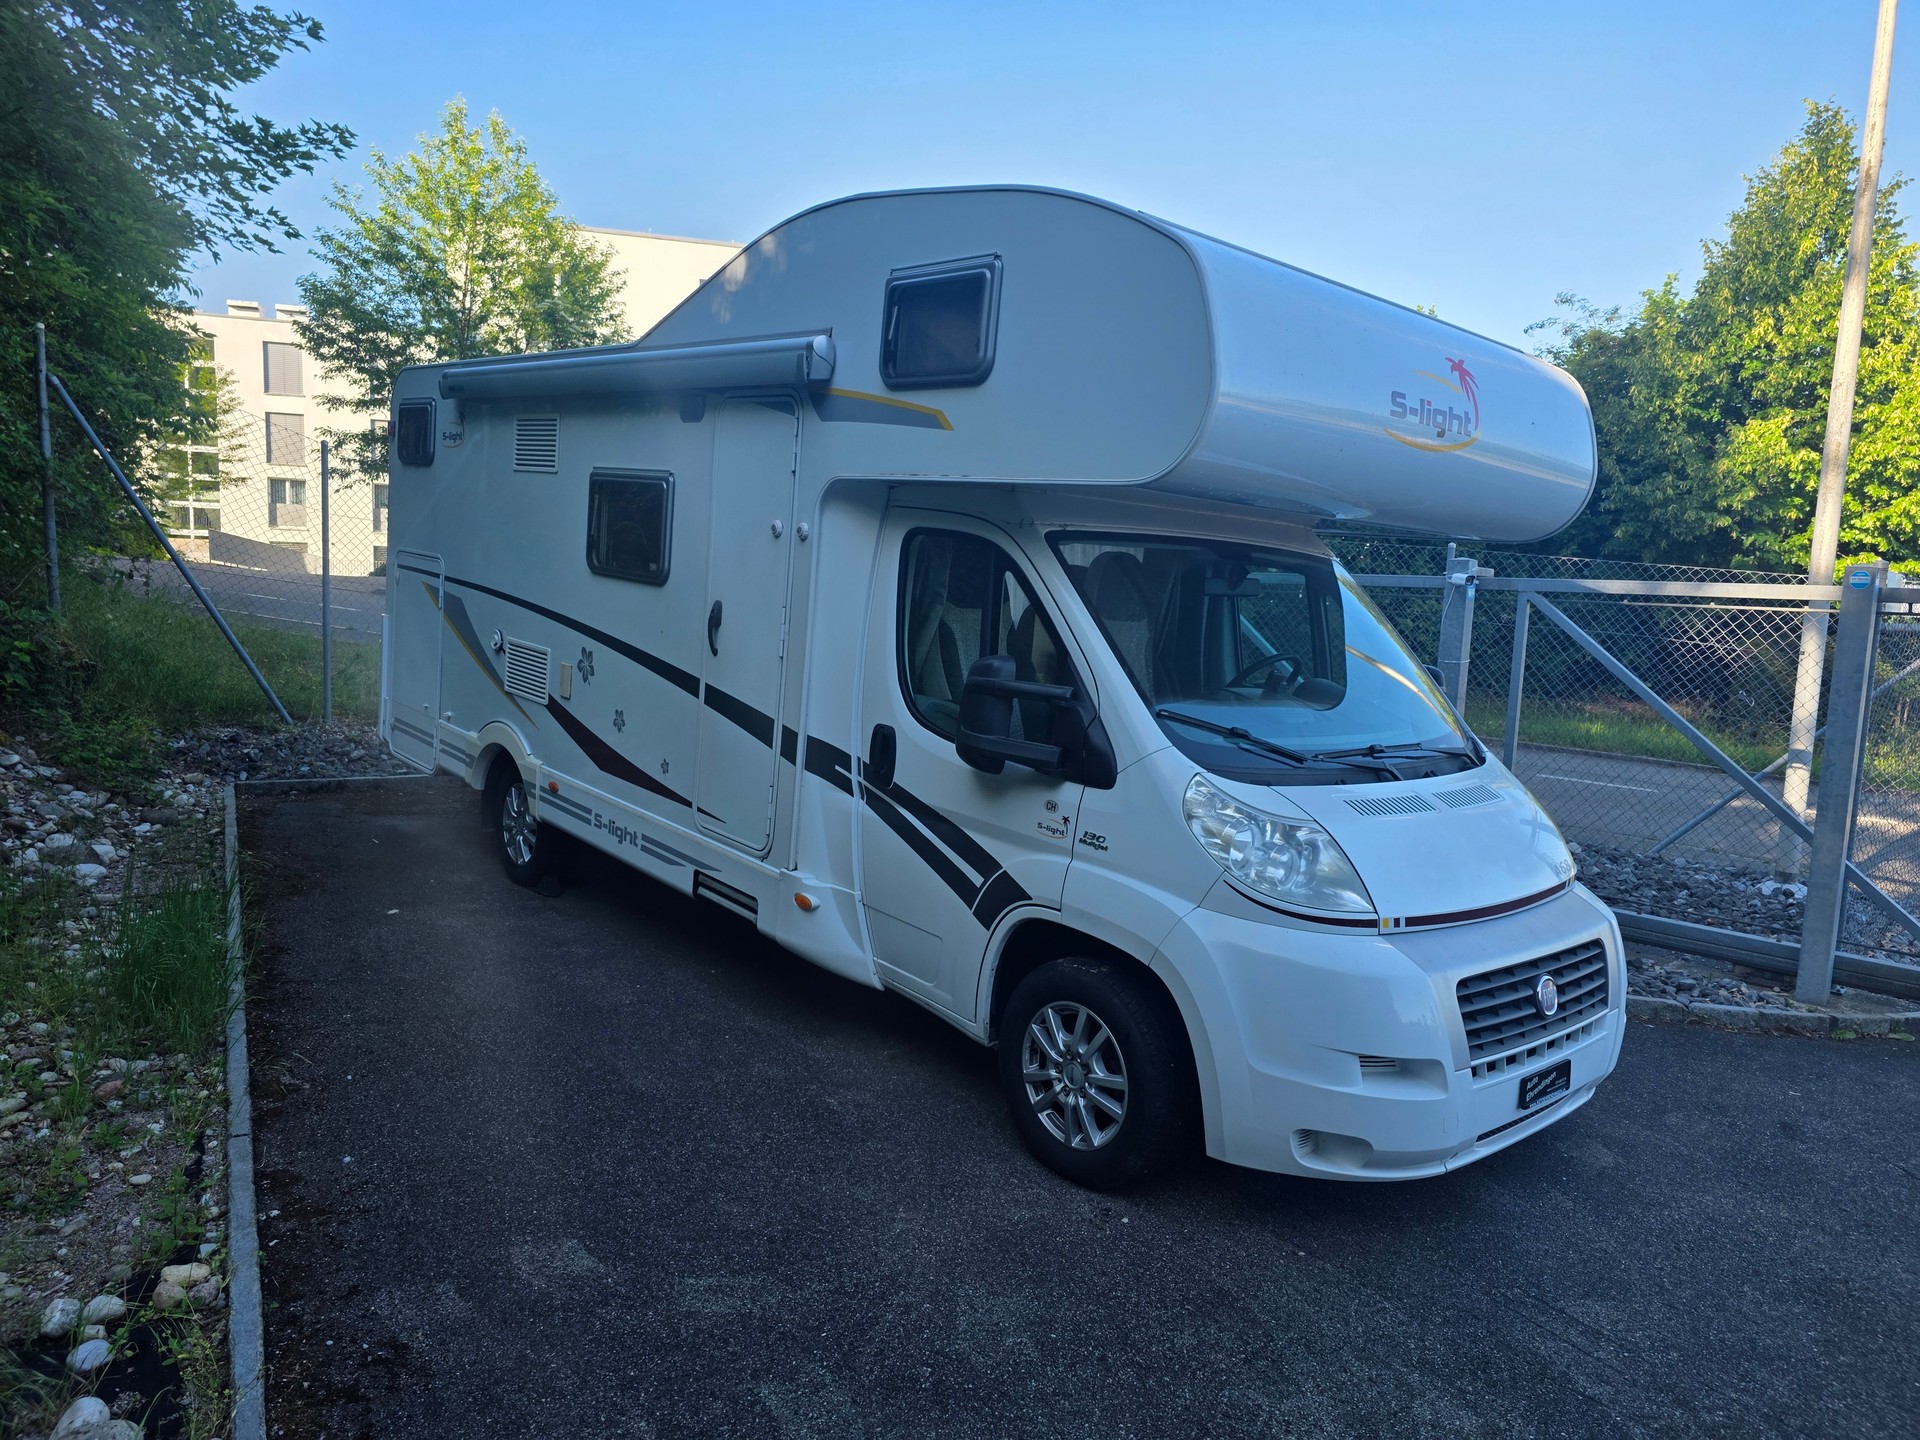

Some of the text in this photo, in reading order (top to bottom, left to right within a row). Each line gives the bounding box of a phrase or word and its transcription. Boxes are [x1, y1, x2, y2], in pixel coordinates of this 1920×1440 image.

[1389, 390, 1471, 438] S-light
[442, 431, 463, 444] S-light
[1046, 801, 1057, 813] CH
[593, 812, 638, 848] S-light
[1037, 822, 1065, 836] S-light
[1082, 830, 1106, 843] 130
